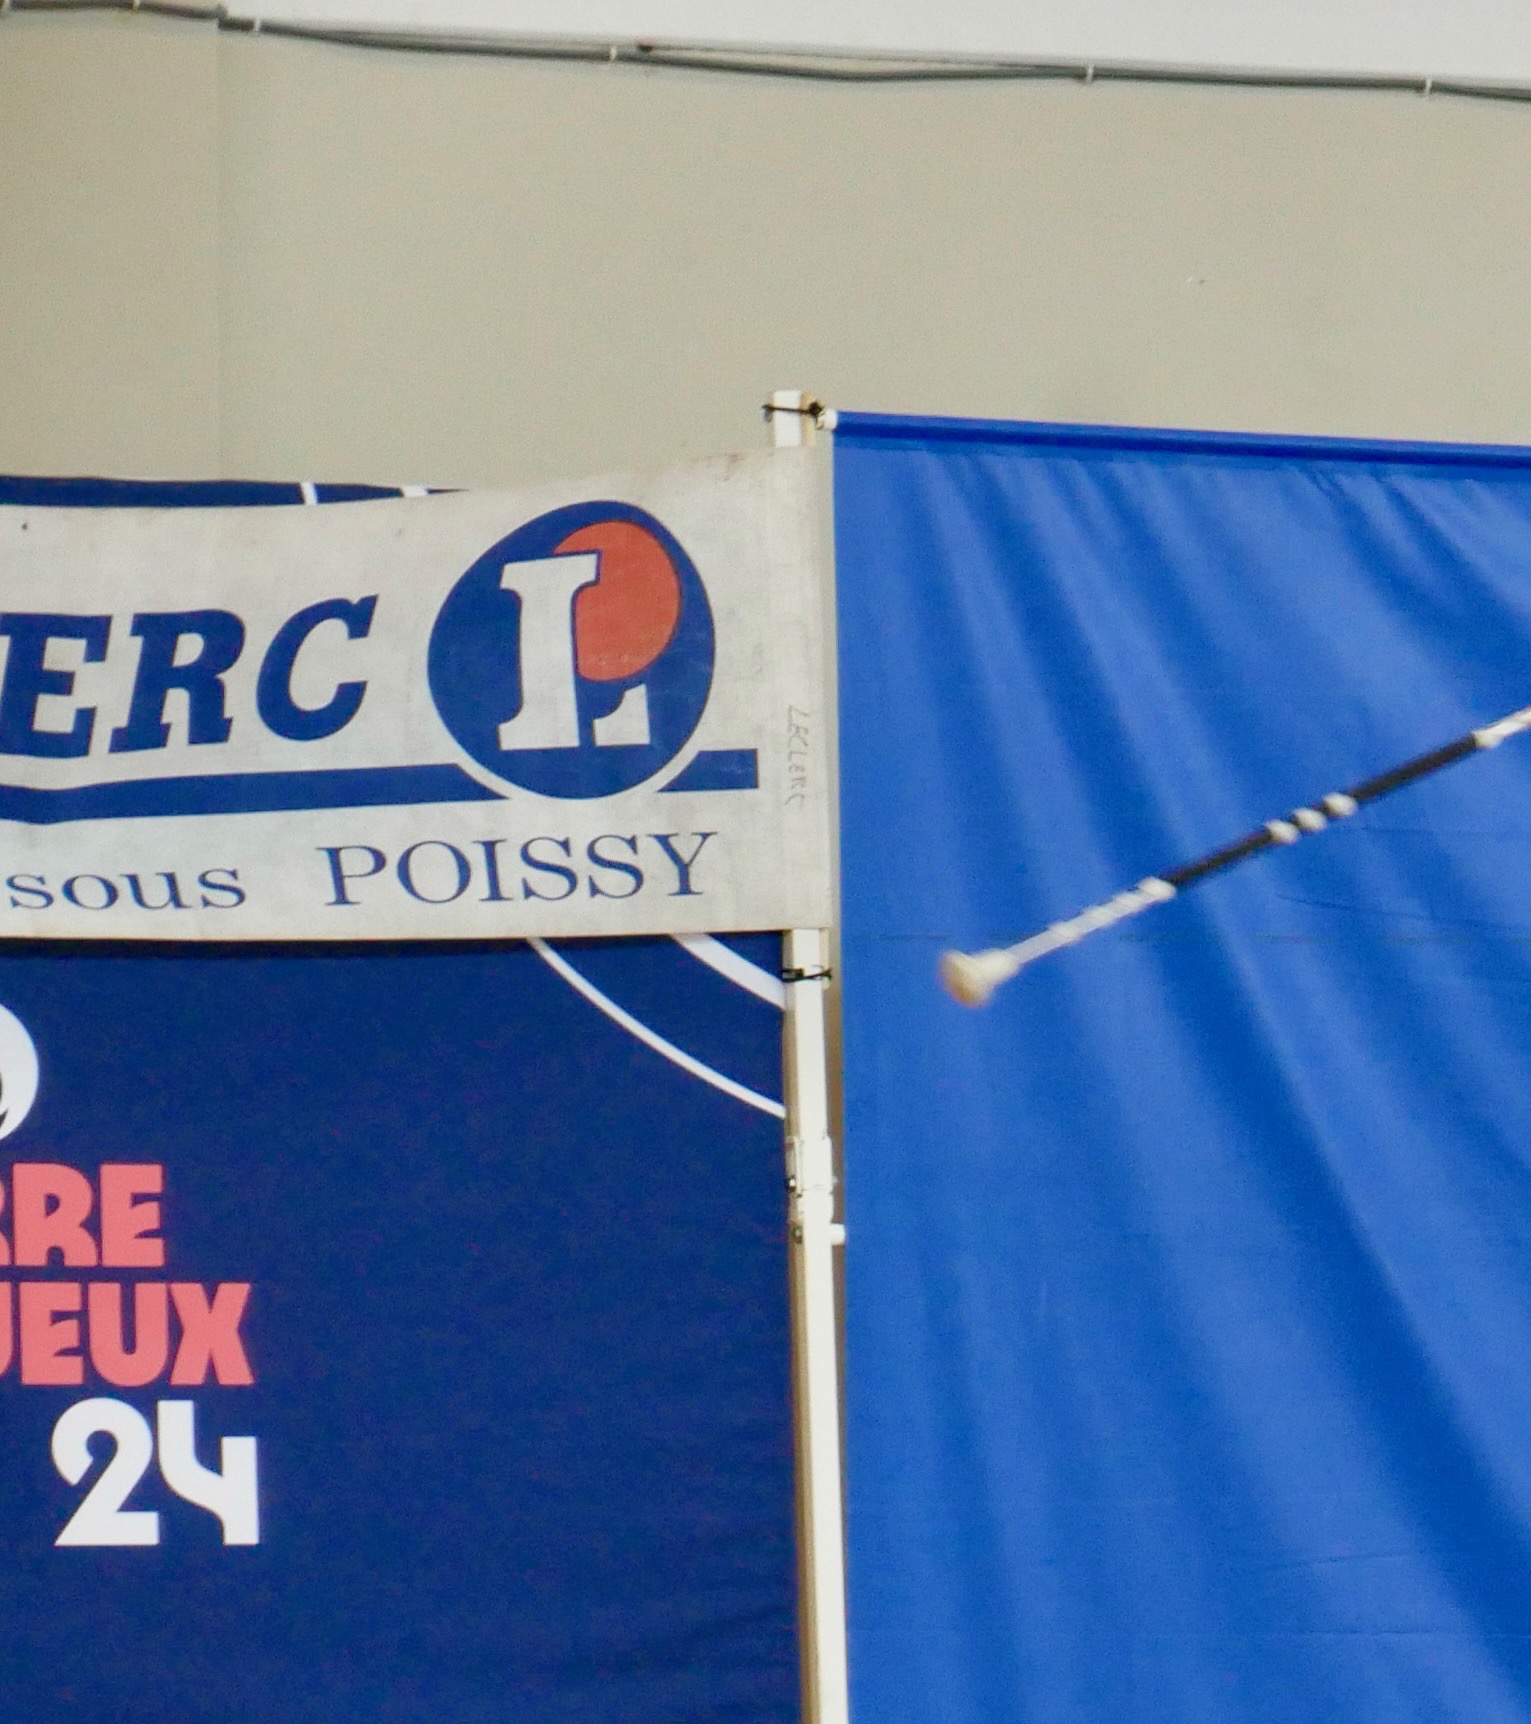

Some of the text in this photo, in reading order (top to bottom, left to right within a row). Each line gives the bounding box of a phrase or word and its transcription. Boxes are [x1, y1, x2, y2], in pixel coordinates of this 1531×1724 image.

[8, 831, 719, 911] sous POISSY
[0, 1163, 166, 1268] RE
[51, 1397, 260, 1546] 24
